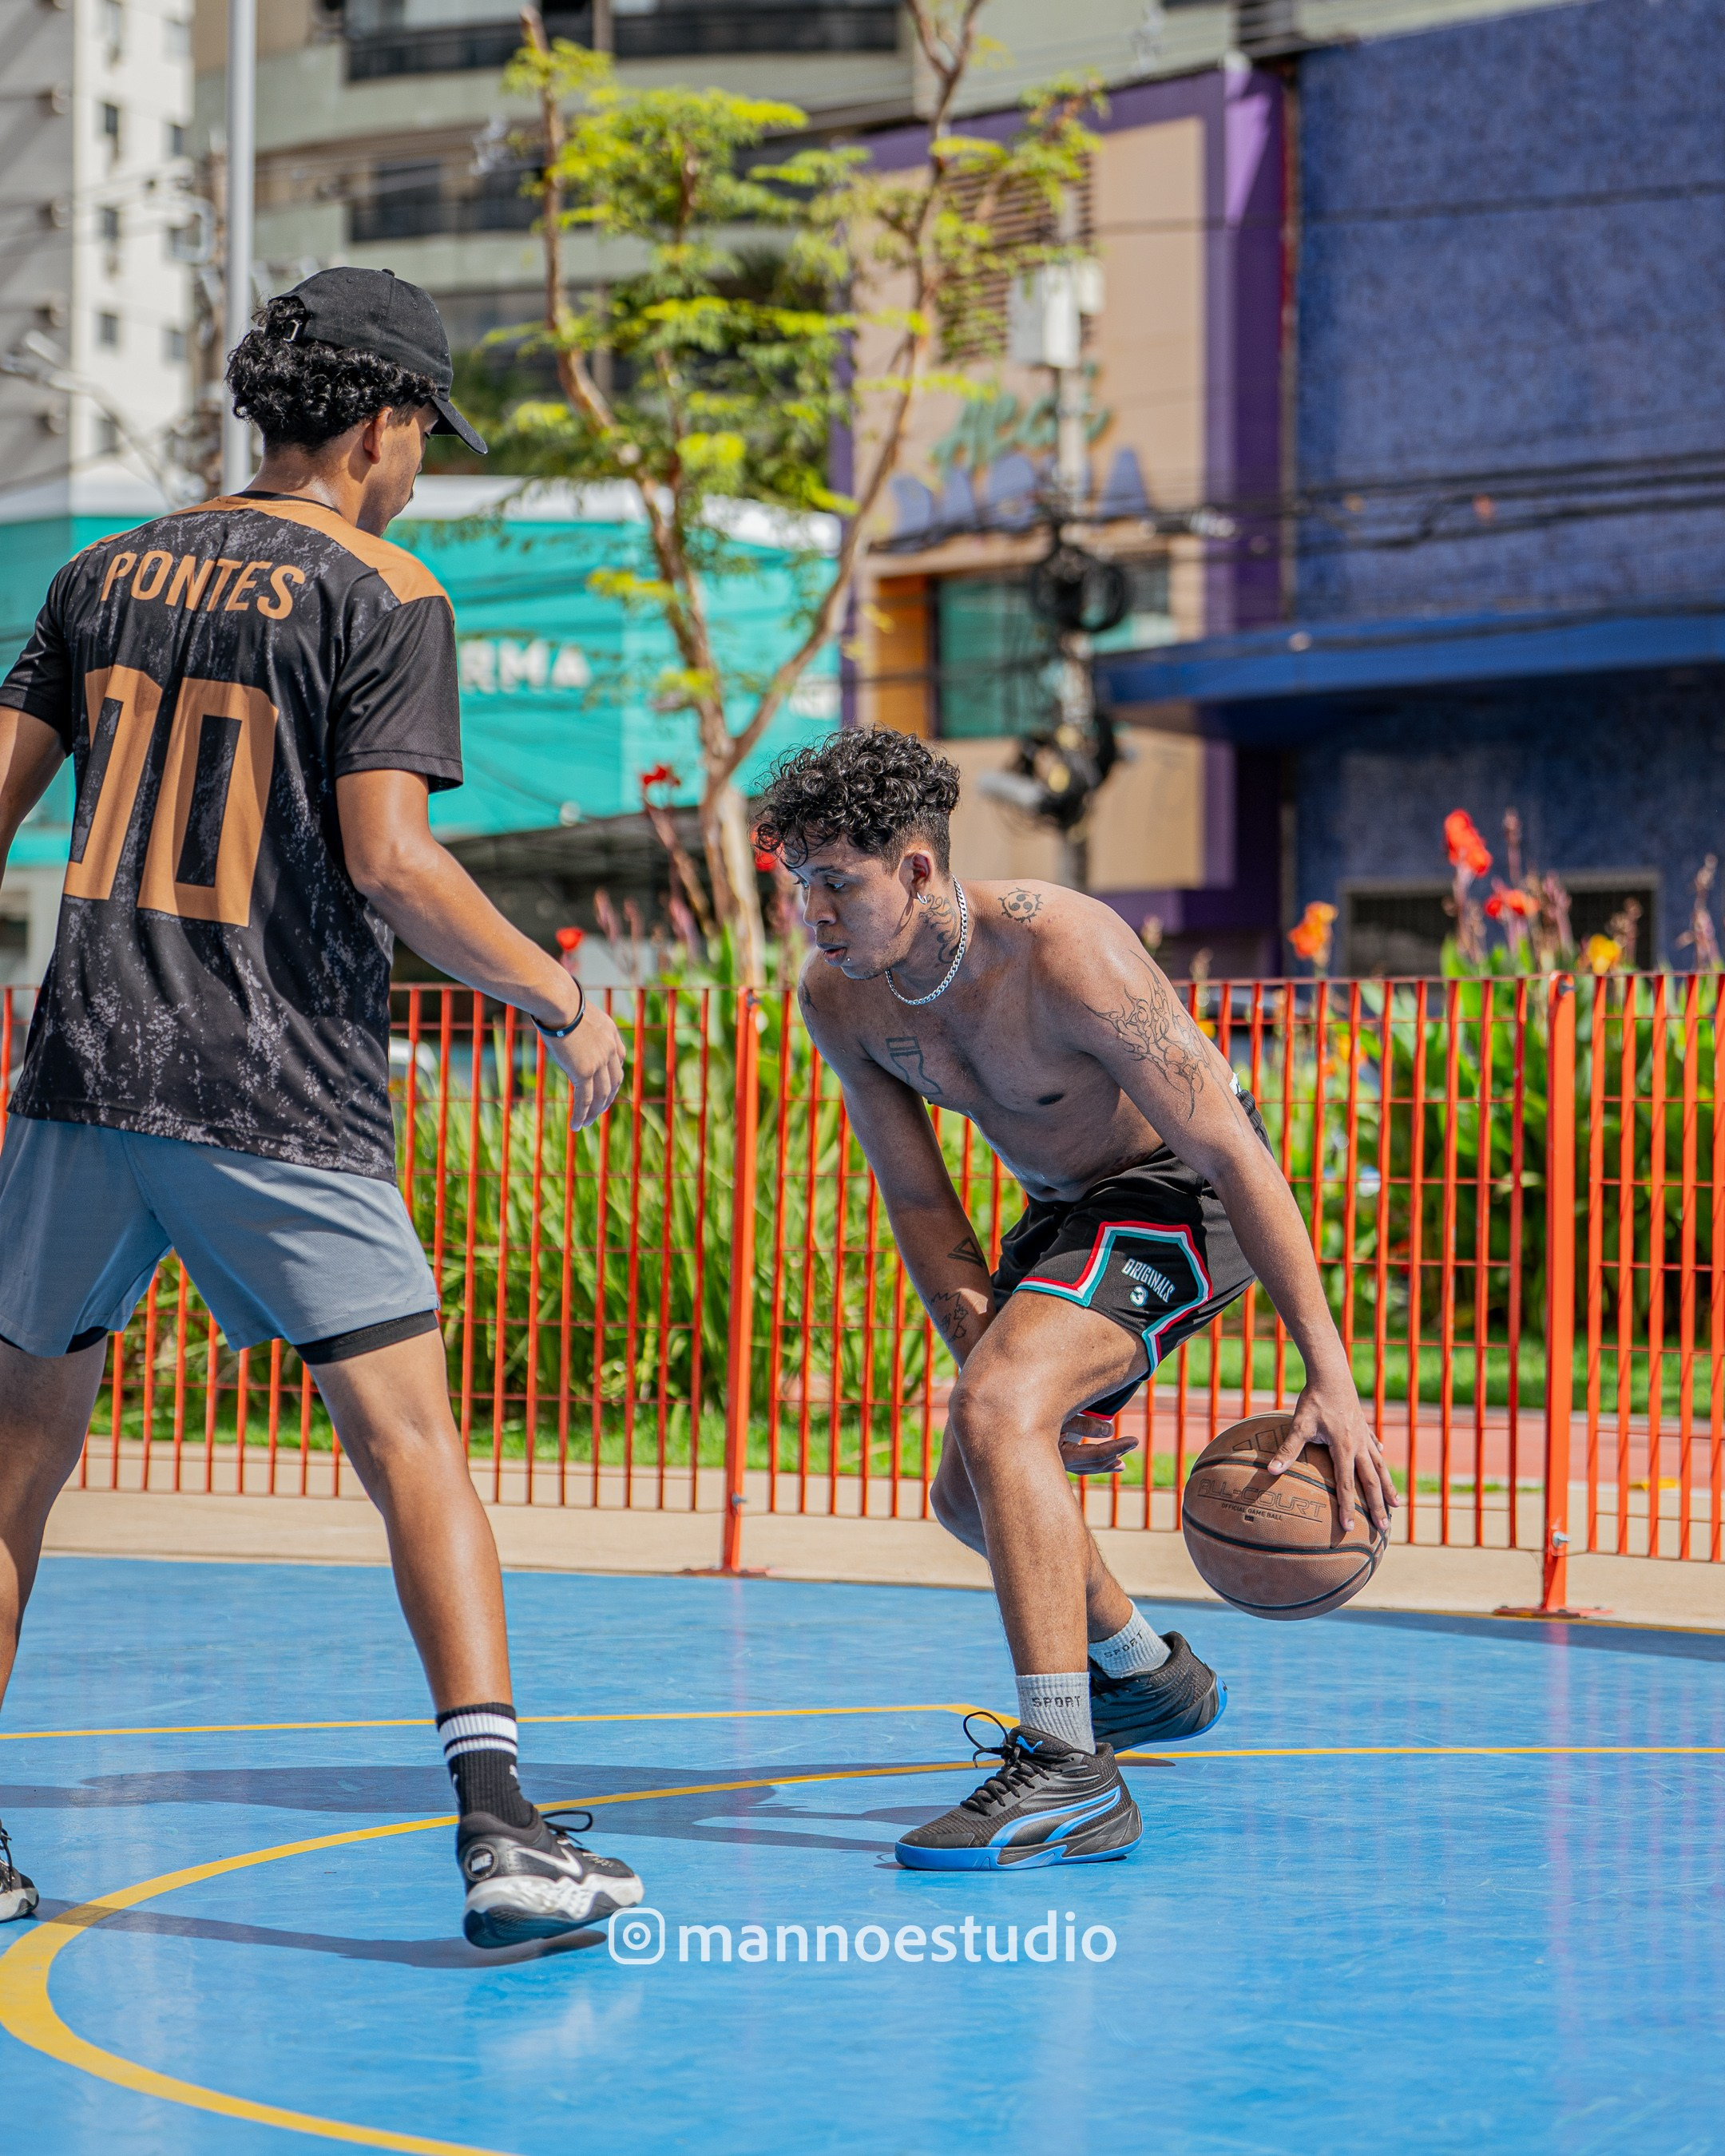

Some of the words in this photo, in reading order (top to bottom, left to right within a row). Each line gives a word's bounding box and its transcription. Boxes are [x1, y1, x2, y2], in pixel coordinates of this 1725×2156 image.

[101, 550, 306, 620] PONTES
[1121, 1258, 1176, 1303] ORIGINALS
[1130, 1286, 1148, 1307] 3
[1200, 1479, 1326, 1517] ALL-COURT
[1221, 1503, 1246, 1513] OFFICIAL
[1247, 1508, 1265, 1517] GAME
[1266, 1512, 1283, 1521] BALL
[1103, 1629, 1143, 1658] SPORT
[1032, 1695, 1081, 1707] SPORT
